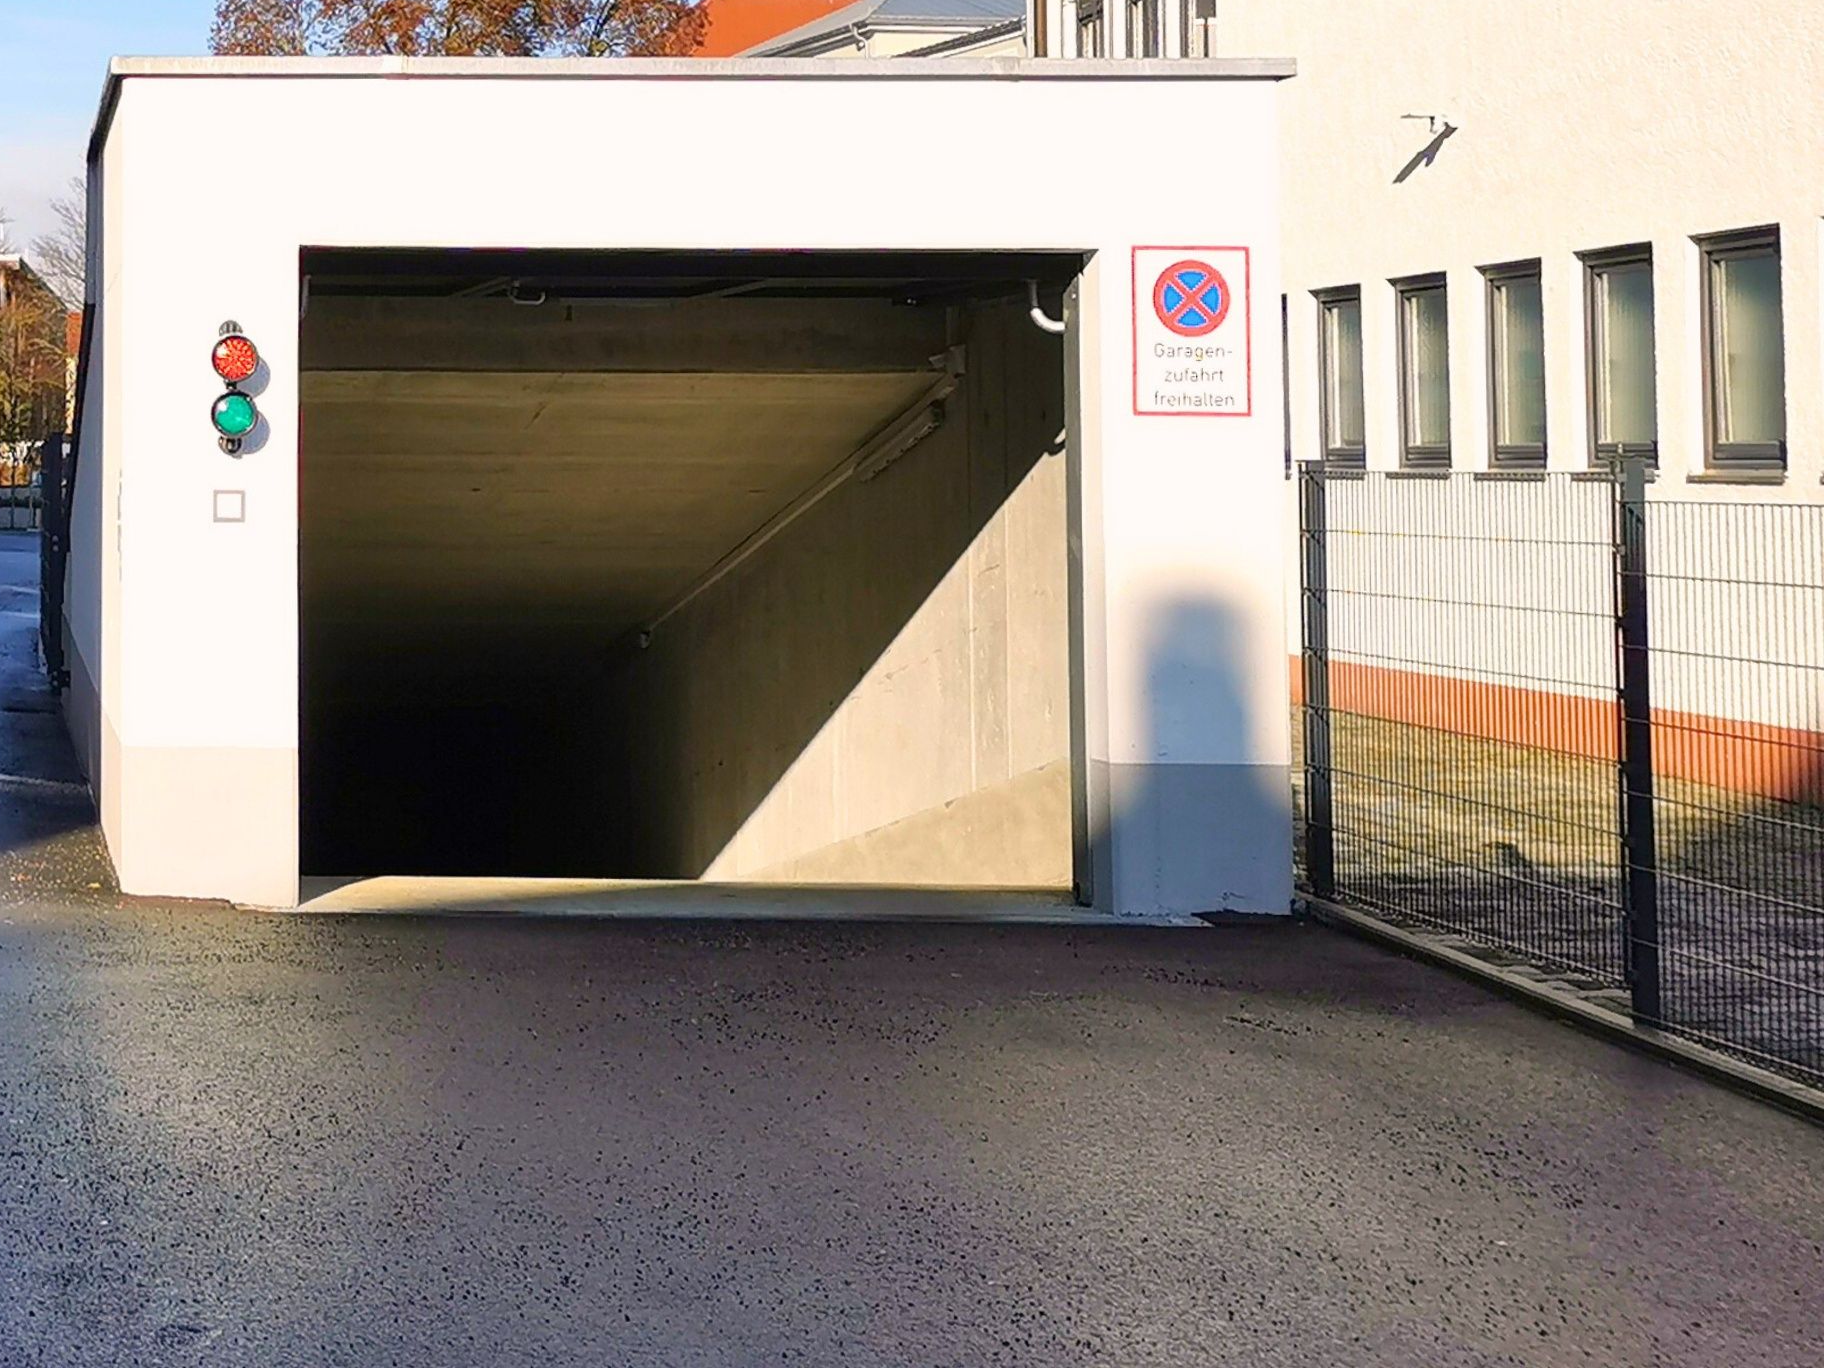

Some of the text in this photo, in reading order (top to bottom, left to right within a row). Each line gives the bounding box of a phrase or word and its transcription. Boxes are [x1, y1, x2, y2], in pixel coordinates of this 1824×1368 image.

[1153, 342, 1233, 362] Garagen-
[1163, 367, 1225, 383] zufahrt
[1153, 390, 1236, 407] freihalten
